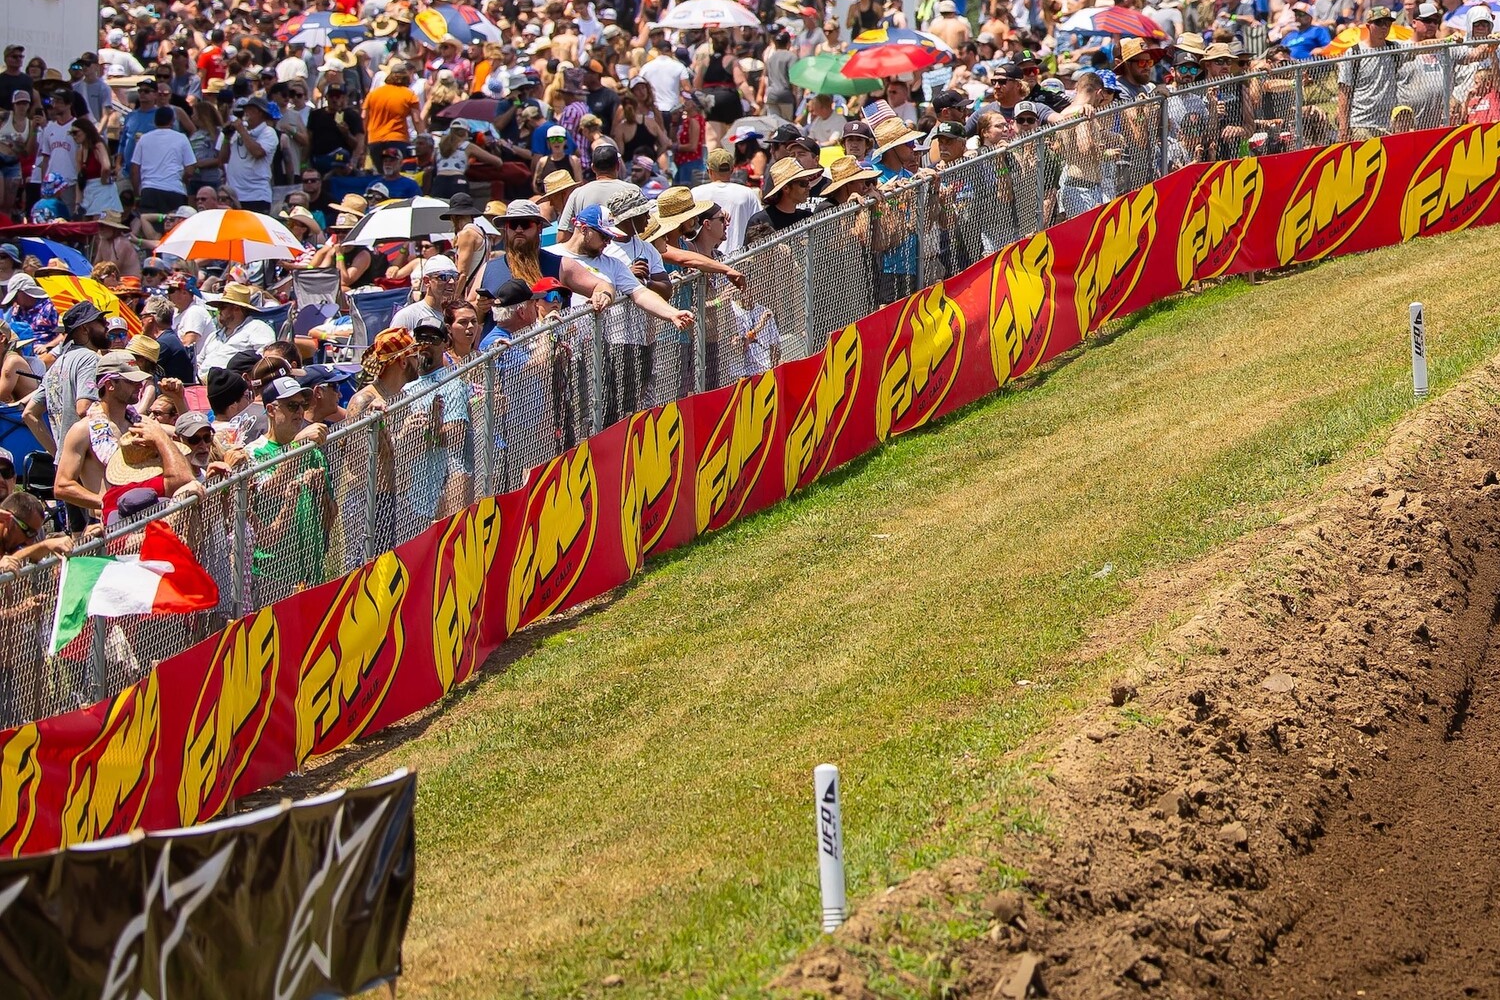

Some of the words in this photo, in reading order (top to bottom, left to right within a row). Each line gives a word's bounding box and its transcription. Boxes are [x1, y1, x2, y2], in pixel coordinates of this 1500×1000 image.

[1079, 184, 1154, 340] FMF
[1182, 157, 1257, 289] FMF
[1280, 137, 1381, 266] FMF
[877, 281, 955, 442] FMF
[993, 232, 1048, 387] FMF
[1413, 326, 1422, 357] UFO
[623, 403, 680, 579] FMF
[697, 369, 776, 535] FMF
[786, 325, 857, 497] FMF
[435, 498, 496, 695] FMF
[507, 441, 591, 637] FMF
[183, 606, 274, 827] FMF
[299, 550, 405, 768] FMF
[821, 806, 834, 858] UFO
